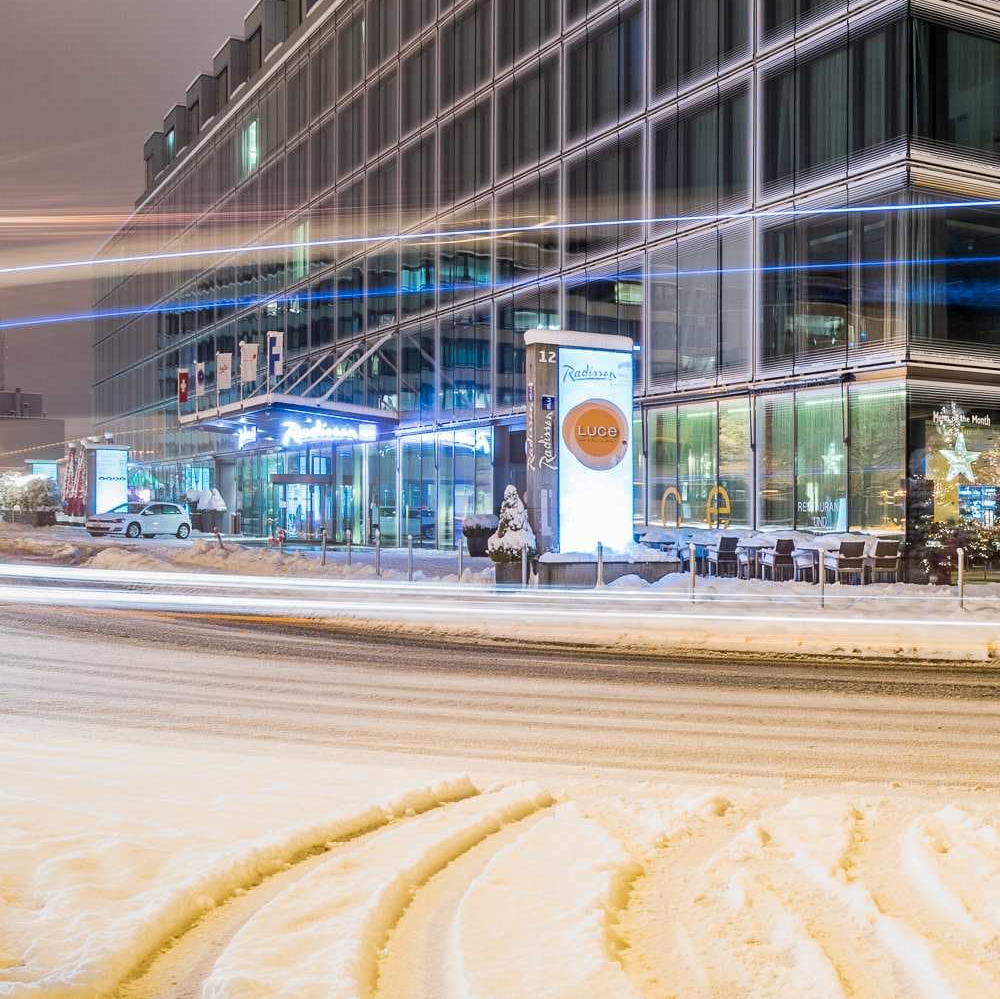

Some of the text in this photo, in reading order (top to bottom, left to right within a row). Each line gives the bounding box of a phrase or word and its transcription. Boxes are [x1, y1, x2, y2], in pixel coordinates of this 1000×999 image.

[538, 351, 557, 363] 12
[562, 364, 617, 384] Radisson
[960, 414, 970, 423] the
[971, 414, 991, 426] Month
[539, 411, 558, 471] Radisson
